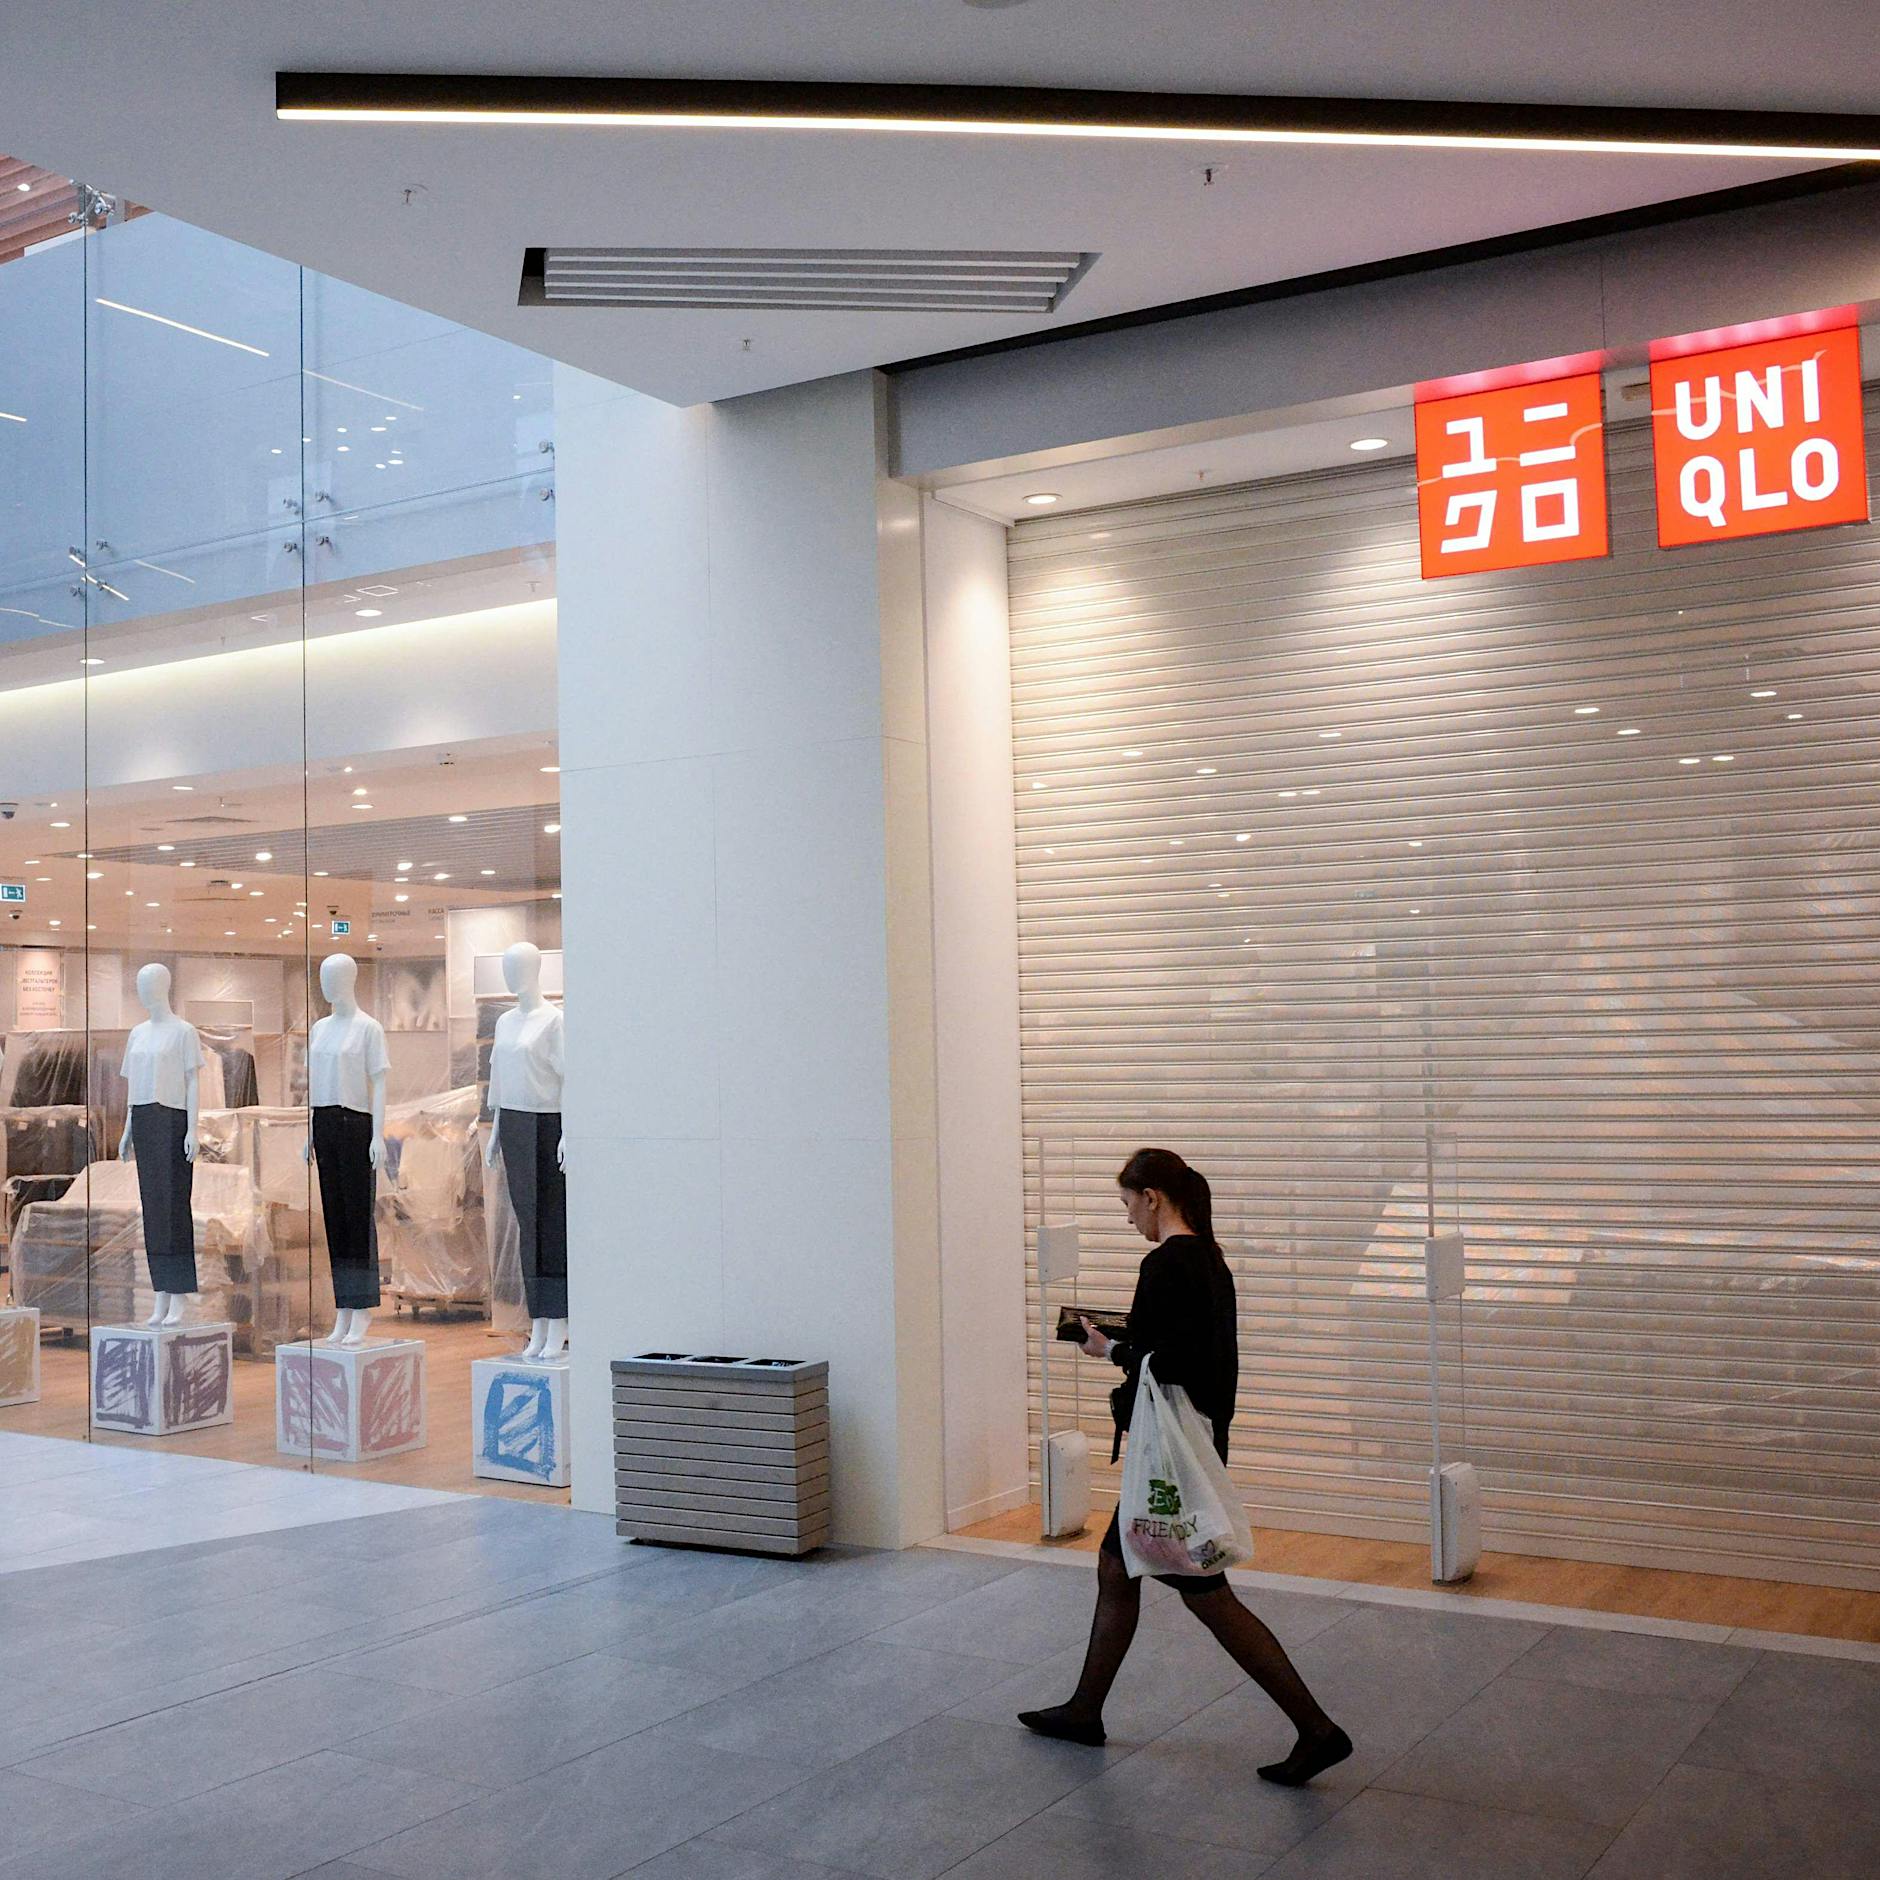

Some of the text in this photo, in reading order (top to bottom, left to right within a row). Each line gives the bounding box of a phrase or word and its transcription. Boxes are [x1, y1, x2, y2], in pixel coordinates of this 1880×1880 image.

[1675, 359, 1820, 440] UNI
[1442, 402, 1576, 479] ユニ
[1440, 477, 1580, 554] クロ
[1679, 437, 1839, 527] QLO
